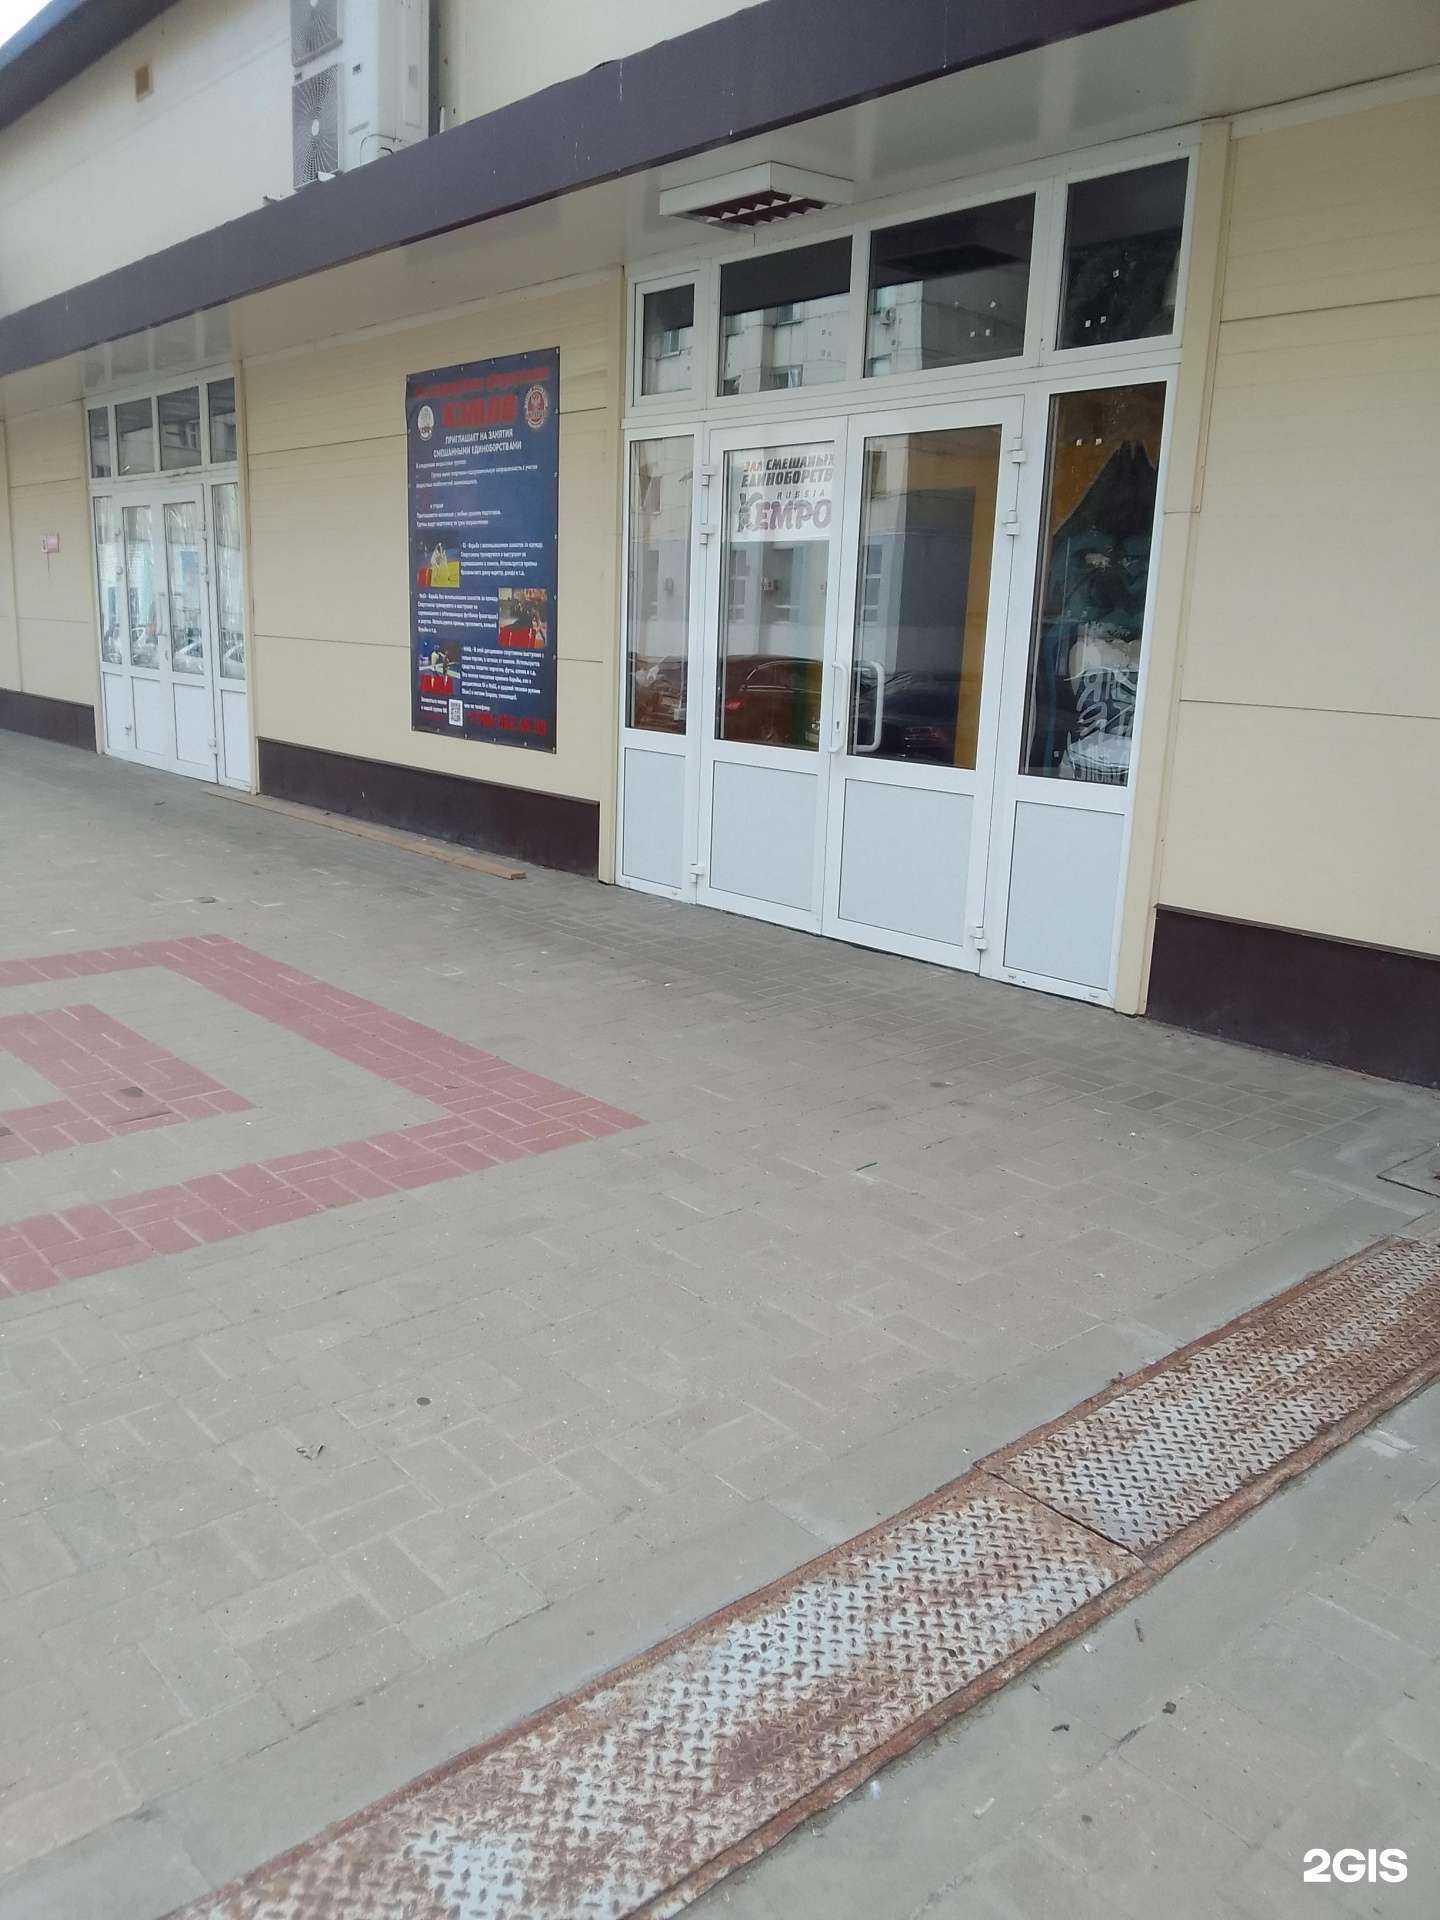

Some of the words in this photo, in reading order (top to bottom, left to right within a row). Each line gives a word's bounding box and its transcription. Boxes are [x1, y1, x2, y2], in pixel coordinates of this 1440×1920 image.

[445, 432, 479, 445] ПРИГЛАШАЕТ
[479, 430, 488, 441] НА
[488, 428, 513, 440] ЗАНЯТИЯ
[471, 440, 522, 455] ЕДИНОБОРСТВАМИ
[776, 489, 825, 501] RUSSIA
